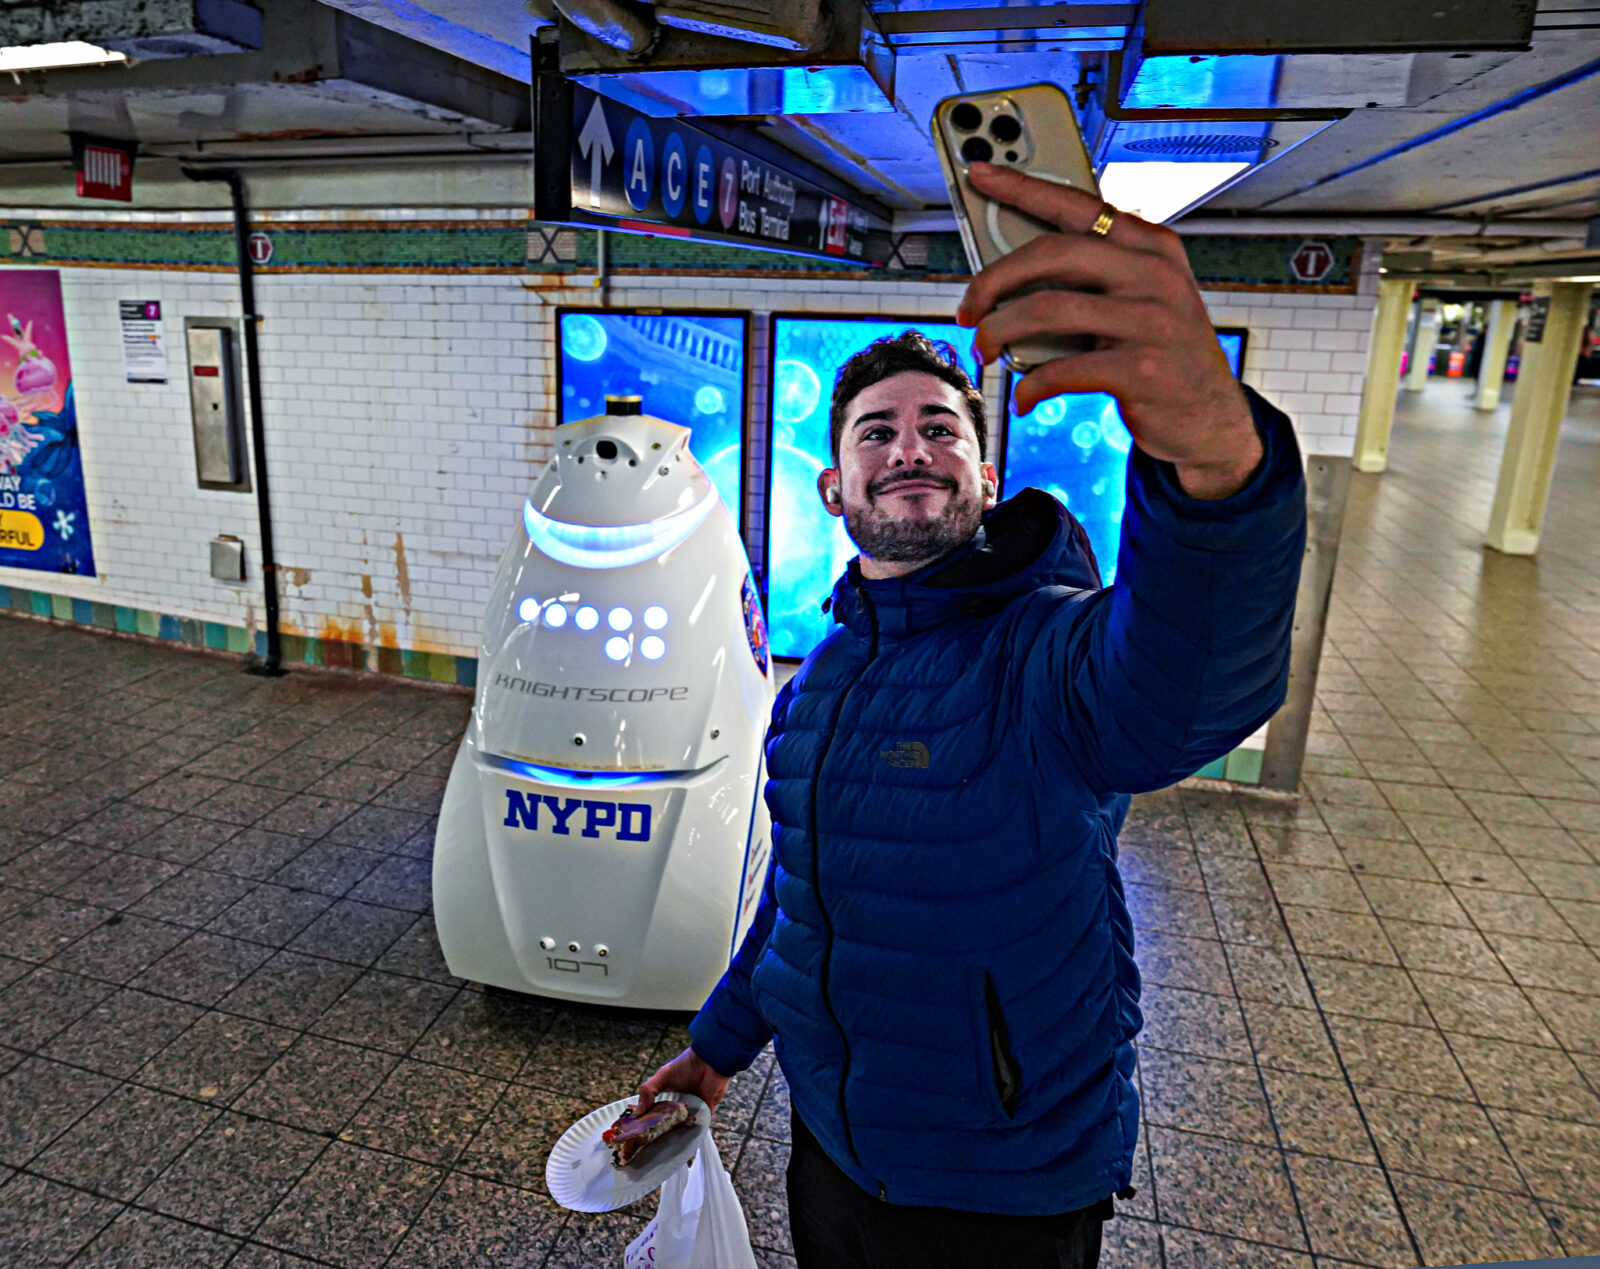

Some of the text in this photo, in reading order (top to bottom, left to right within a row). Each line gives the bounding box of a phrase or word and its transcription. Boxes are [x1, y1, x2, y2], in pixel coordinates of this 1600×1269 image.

[630, 138, 734, 213] A C E 7
[741, 159, 796, 214] Port Authority
[738, 200, 791, 241] Bus Terminal
[1301, 250, 1325, 275] T
[17, 493, 37, 511] BE
[495, 673, 689, 702] KNIGHTSCOPE
[503, 789, 652, 842] NYPD
[546, 957, 608, 976] 107
